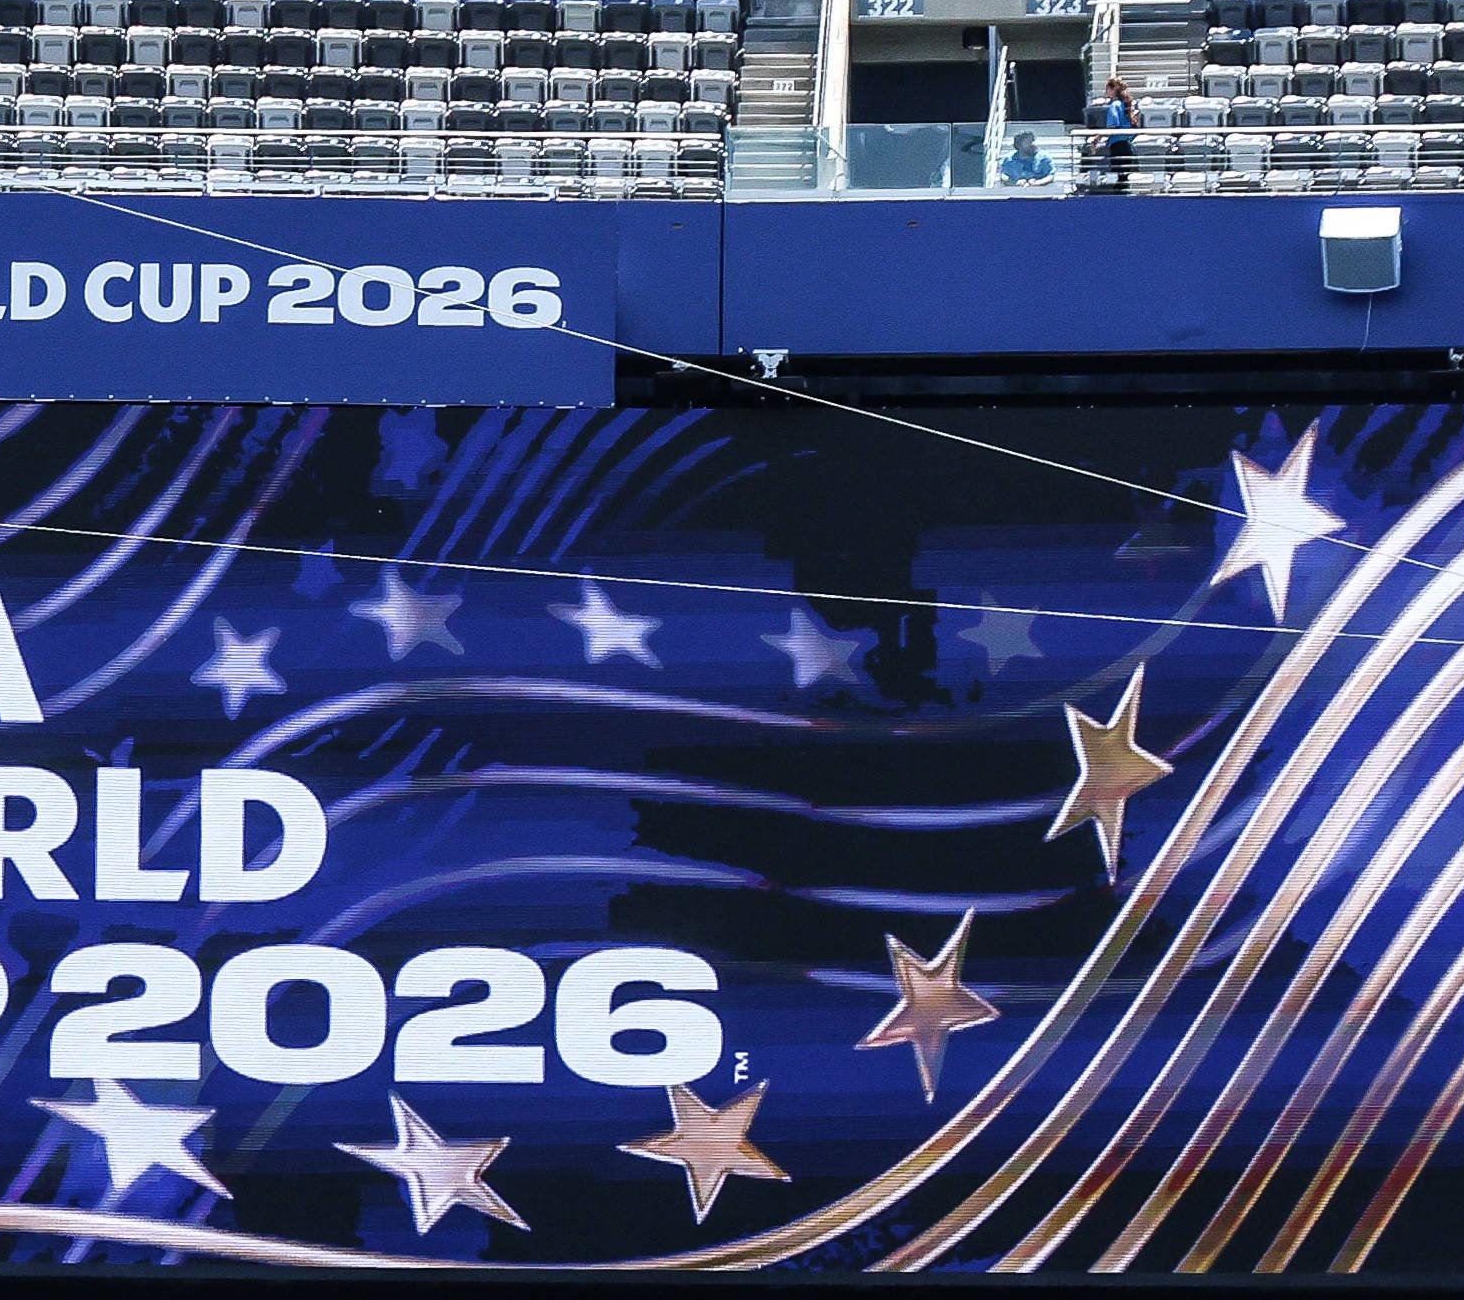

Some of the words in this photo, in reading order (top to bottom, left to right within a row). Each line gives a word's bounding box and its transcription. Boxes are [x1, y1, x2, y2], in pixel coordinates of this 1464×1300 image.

[85, 262, 250, 322] CUP
[268, 268, 562, 329] 2026
[49, 944, 722, 1085] 2026
